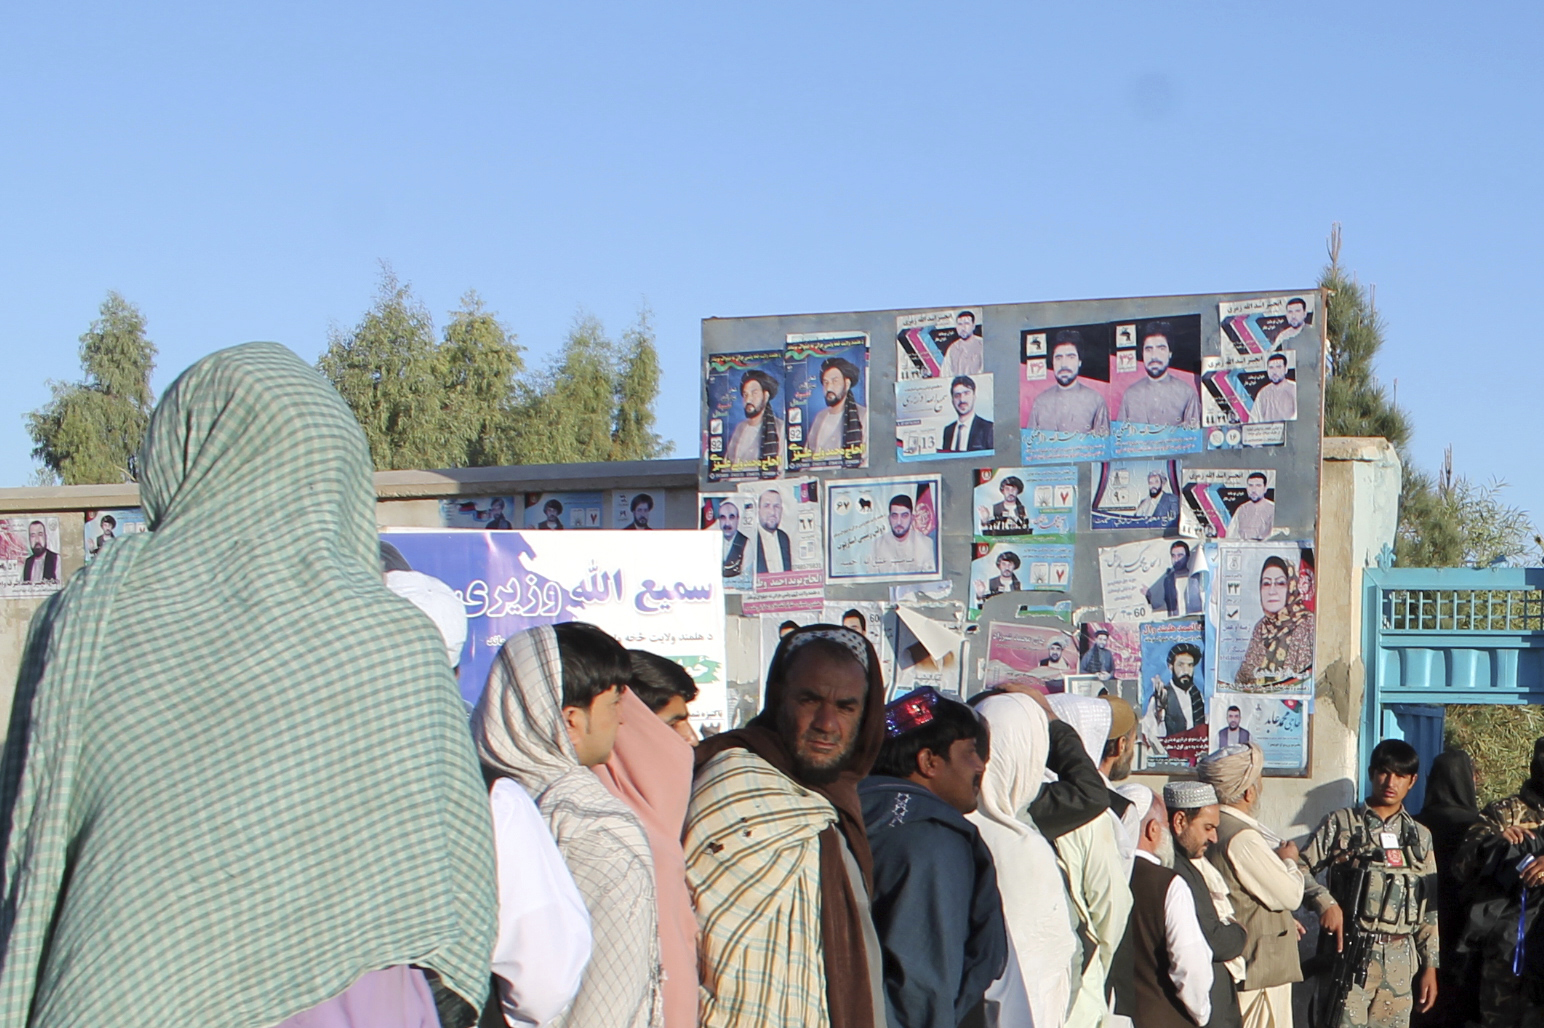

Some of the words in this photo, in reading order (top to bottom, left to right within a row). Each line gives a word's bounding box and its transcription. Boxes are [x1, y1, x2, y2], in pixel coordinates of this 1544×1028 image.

[789, 429, 801, 439] 92
[711, 440, 722, 451] 92
[921, 436, 936, 450] 13
[743, 516, 753, 526] 32
[569, 559, 624, 606] الله
[634, 578, 714, 615] سمیع
[869, 613, 880, 623] 60
[1133, 607, 1146, 618] 60
[648, 632, 676, 645] ولایت
[678, 632, 705, 642] هلمند
